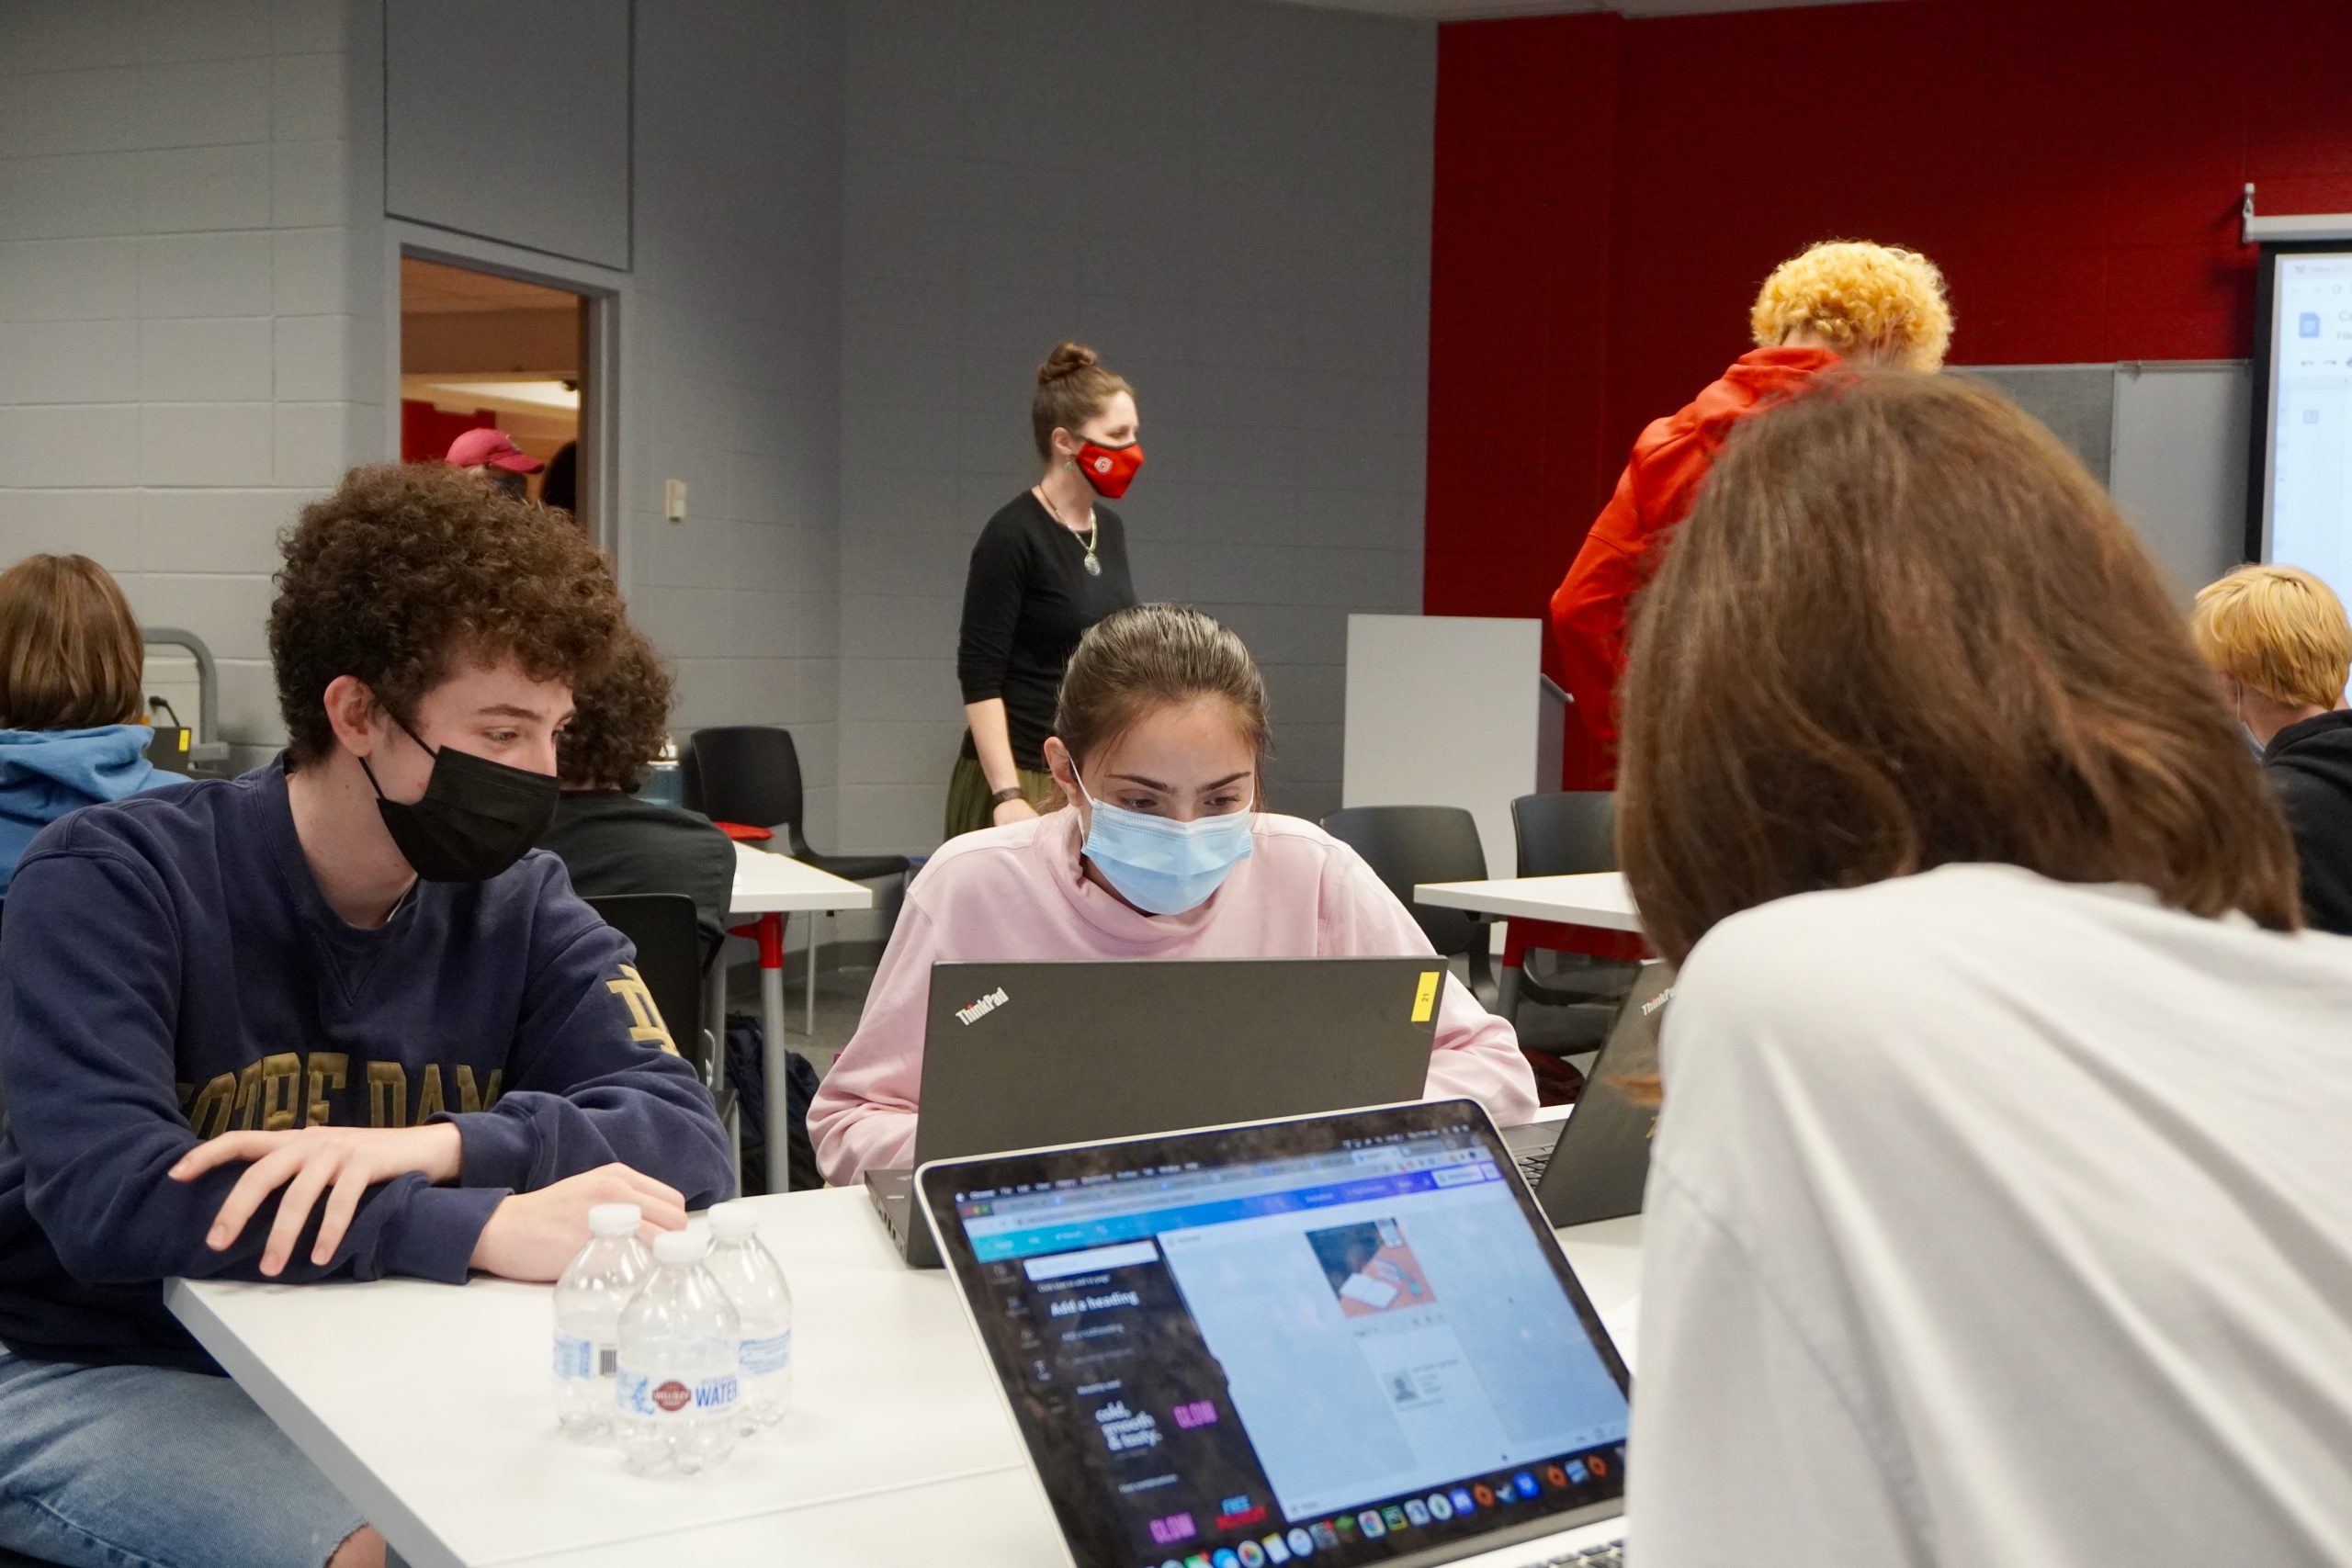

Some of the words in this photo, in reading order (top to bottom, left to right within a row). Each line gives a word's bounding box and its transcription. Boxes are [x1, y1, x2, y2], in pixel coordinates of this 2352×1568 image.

[955, 987, 1010, 1026] ThinkPad
[1640, 987, 1676, 1016] ThinkPa
[1086, 1291, 1139, 1310] heading
[695, 1379, 737, 1407] WATER
